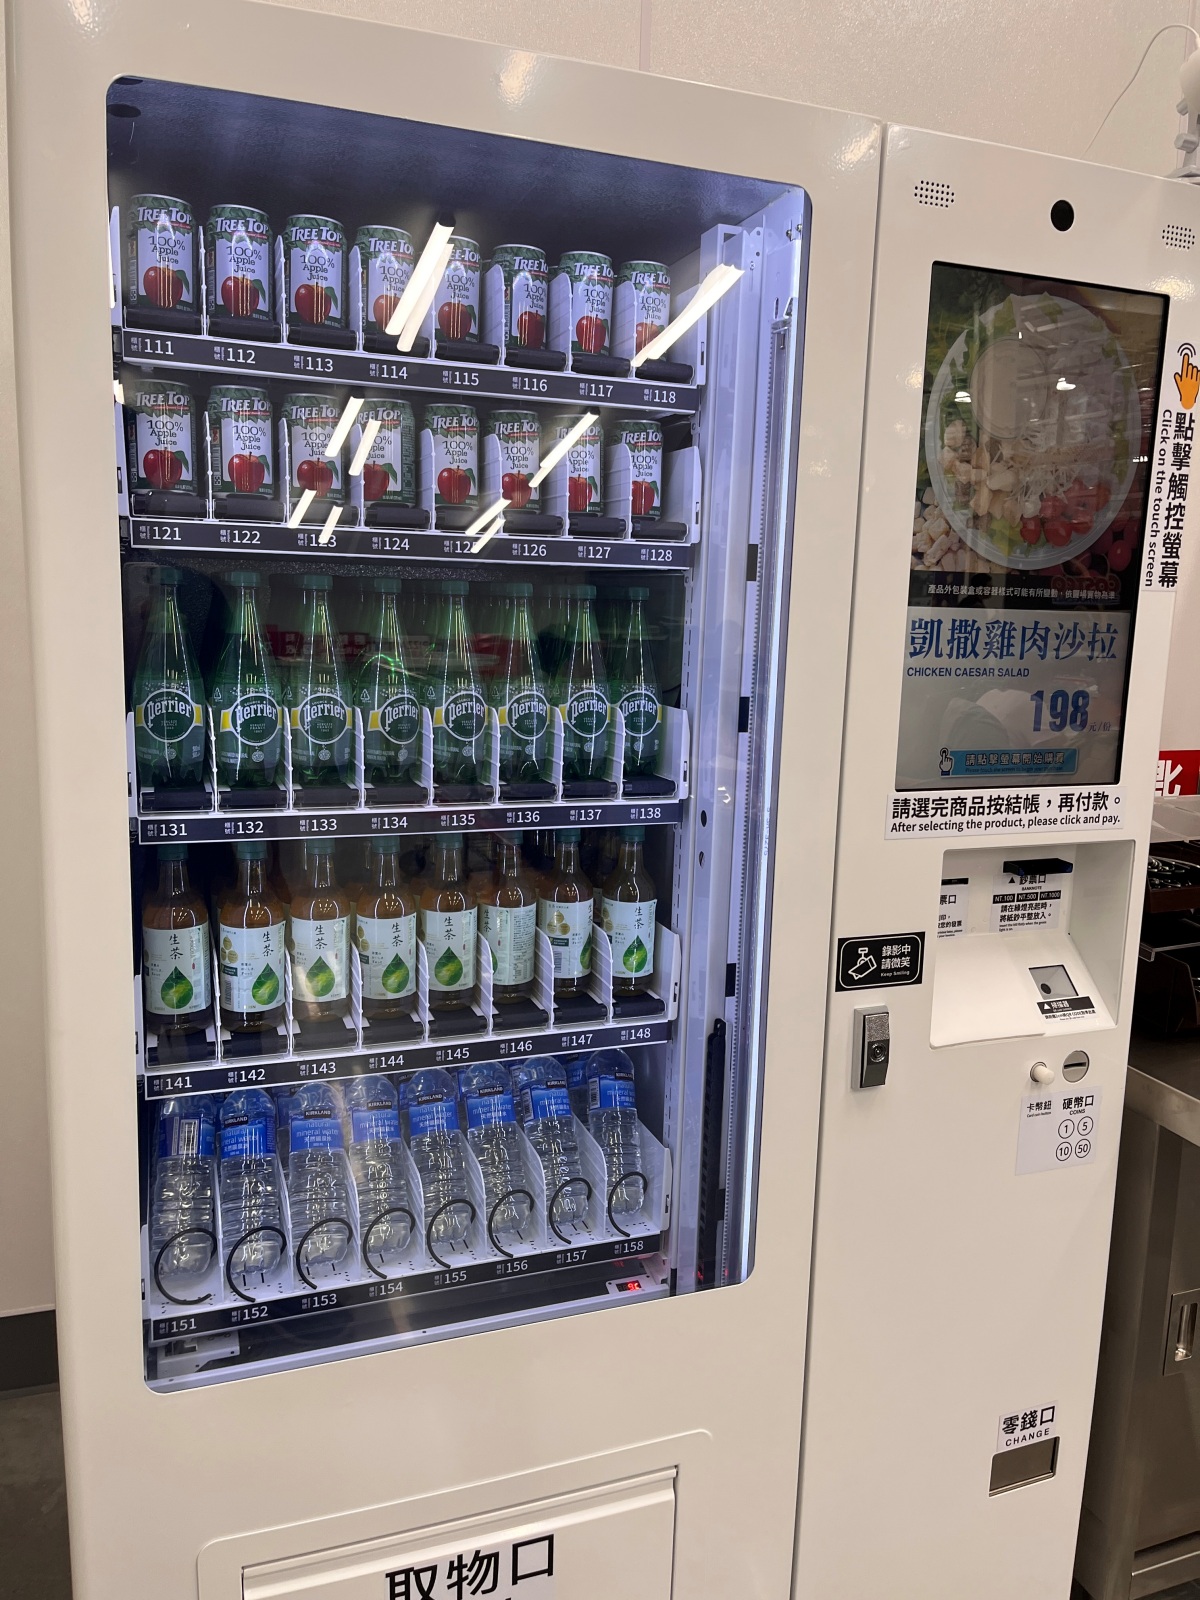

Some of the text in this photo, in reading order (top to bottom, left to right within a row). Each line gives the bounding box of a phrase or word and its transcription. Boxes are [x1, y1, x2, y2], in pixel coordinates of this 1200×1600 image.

[137, 206, 168, 223] TREE
[216, 217, 245, 232] TREE
[291, 227, 319, 242] TREE
[148, 236, 186, 251] 100%
[369, 238, 397, 252] TREE
[152, 245, 179, 257] Apple
[227, 245, 262, 260] 100%
[156, 254, 179, 265] Juice
[229, 255, 256, 267] Apple
[301, 255, 335, 268] 100%
[234, 264, 256, 274] Juice
[303, 264, 328, 275] Apple
[574, 263, 597, 276] TREE
[307, 272, 328, 282] Juice
[447, 275, 475, 287] 100%
[631, 271, 656, 284] TREE
[144, 339, 174, 355] 111
[226, 348, 256, 364] 112
[306, 357, 333, 372] 113
[381, 365, 408, 380] 114
[454, 371, 480, 386] 115
[522, 377, 548, 392] 116
[589, 383, 613, 397] 117
[136, 391, 166, 407] TREE
[653, 389, 676, 403] 118
[220, 397, 251, 412] TREE
[291, 406, 318, 419] TREE
[147, 420, 183, 431] 100%
[432, 416, 460, 429] TREE
[494, 421, 521, 434] TREE
[150, 429, 177, 439] Apple
[232, 425, 266, 437] 100%
[621, 430, 646, 444] TREE
[156, 438, 177, 446] Juice
[236, 434, 260, 444] Apple
[241, 442, 261, 451] Juice
[443, 441, 473, 451] 100%
[504, 446, 534, 457] 100%
[445, 448, 468, 458] Apple
[506, 454, 528, 464] Apple
[1145, 409, 1172, 587] Click on the touch screen
[1158, 412, 1195, 588] 點擊觸控螢幕
[152, 527, 182, 541] 121
[232, 530, 261, 544] 122
[383, 537, 410, 550] 124
[522, 543, 547, 557] 126
[587, 546, 611, 559] 127
[650, 549, 673, 562] 128
[908, 618, 1118, 661] 凱撒雞肉沙拉
[907, 667, 1030, 678] CHICKEN CAESAR SALAD
[1030, 689, 1090, 733] 198
[892, 791, 1121, 819] 請選完商品按結帳，再付款。
[516, 811, 540, 823] 136
[579, 809, 602, 821] 137
[639, 807, 661, 819] 138
[311, 819, 338, 831] 133
[382, 816, 408, 829] 134
[451, 814, 476, 826] 135
[891, 814, 1121, 832] After selecting the product, please click and pay.
[159, 823, 188, 837] 131
[236, 821, 264, 834] 132
[1040, 891, 1060, 899] NT.1000
[483, 908, 492, 933] 生茶
[634, 906, 645, 929] 生茶
[1000, 912, 1051, 922] 將紙鈔平整放入。
[392, 922, 404, 947] 生茶
[444, 916, 456, 941] 生茶
[262, 931, 275, 957] 生茶
[315, 925, 328, 950] 生茶
[169, 933, 184, 960] 生茶
[881, 944, 911, 956] 錄影中
[881, 957, 911, 969] 請微笑
[571, 1034, 593, 1047] 147
[630, 1028, 651, 1040] 148
[446, 1047, 470, 1060] 145
[510, 1041, 533, 1053] 146
[379, 1054, 404, 1067] 144
[311, 1062, 336, 1075] 143
[239, 1068, 266, 1083] 142
[165, 1076, 192, 1090] 141
[479, 1086, 503, 1095] KIRKLAND
[418, 1093, 442, 1102] KIRKLAND
[1063, 1095, 1094, 1110] 硬幣口
[367, 1101, 391, 1109] KIRKLAND
[1027, 1100, 1051, 1112] 卡幣鈕
[305, 1110, 331, 1118] KIRKLAND
[296, 1128, 320, 1136] mineral
[1059, 1147, 1069, 1156] 10
[1078, 1144, 1088, 1153] 50
[622, 1240, 644, 1252] 158
[565, 1250, 587, 1262] 157
[506, 1260, 529, 1273] 156
[444, 1271, 467, 1284] 155
[379, 1282, 404, 1295] 154
[312, 1294, 337, 1307] 153
[242, 1306, 269, 1320] 152
[171, 1318, 197, 1332] 151
[1002, 1406, 1055, 1435] 零錢口
[1006, 1428, 1050, 1447] CHANGE
[385, 1534, 554, 1600] 取物口
